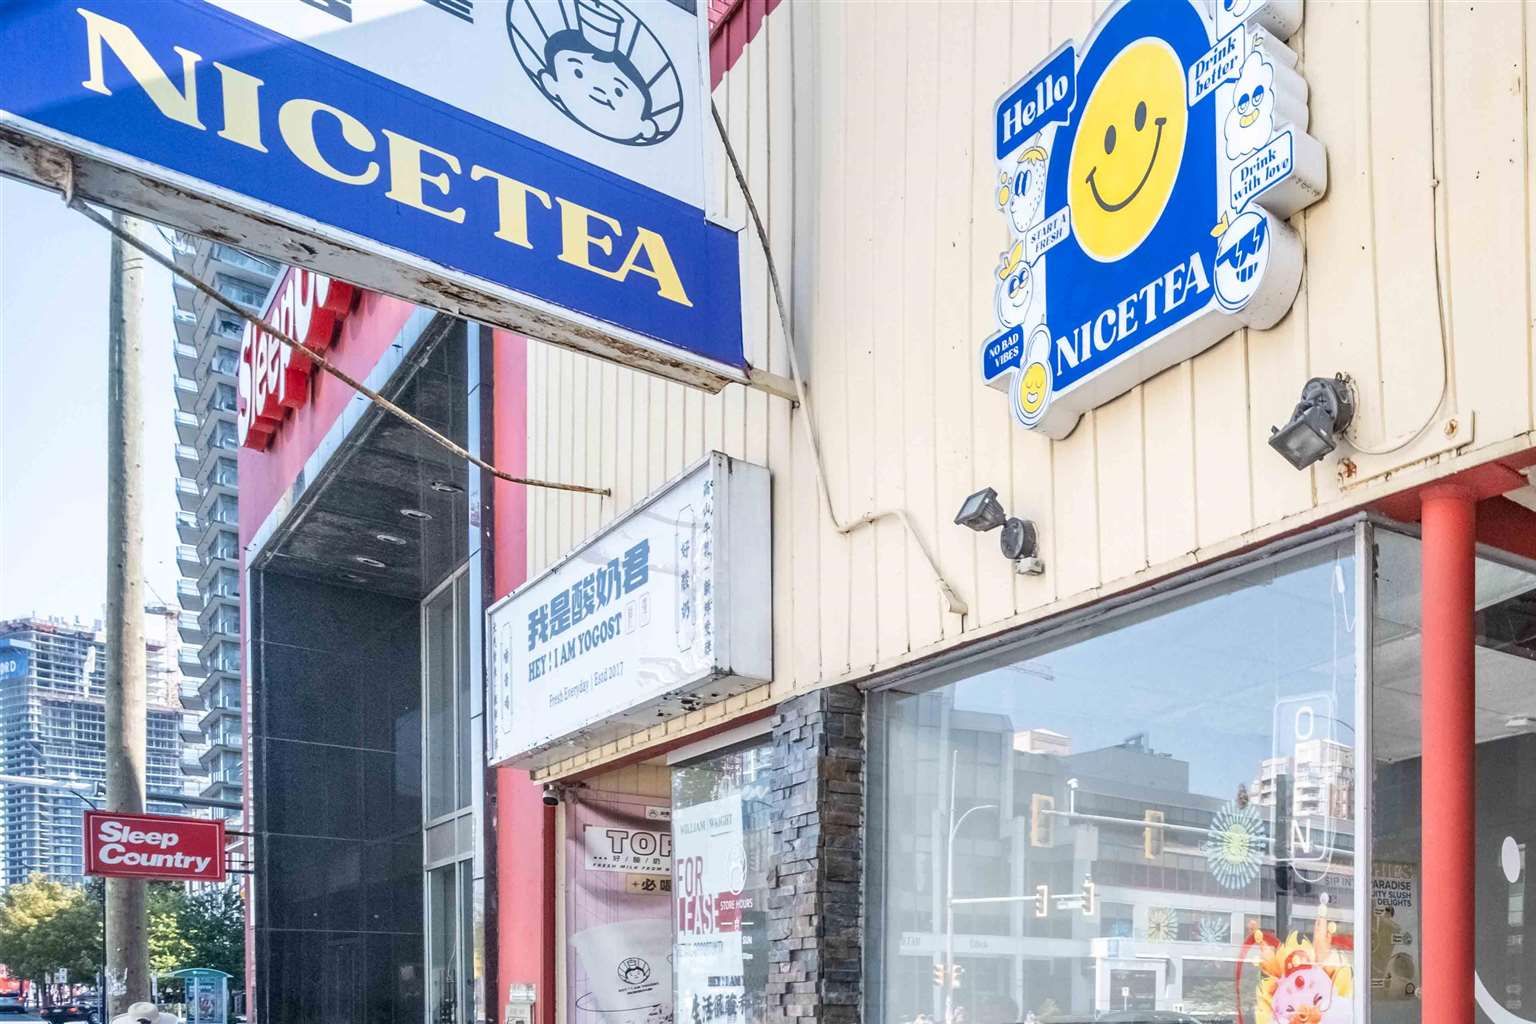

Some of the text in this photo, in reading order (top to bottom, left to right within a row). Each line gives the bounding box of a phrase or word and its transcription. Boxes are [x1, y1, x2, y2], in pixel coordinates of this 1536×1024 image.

[1195, 36, 1237, 80] Drink
[1195, 55, 1238, 98] better
[1002, 73, 1069, 145] Hello
[80, 7, 694, 308] NICETEA
[1240, 148, 1277, 183] Drink
[1233, 157, 1290, 202] with love
[1030, 218, 1059, 245] START
[1034, 227, 1063, 253] FRESH
[1055, 251, 1210, 377] NICETEA
[988, 332, 1019, 359] NO BAD
[995, 346, 1019, 369] VIBES
[528, 537, 650, 652] 我是酸奶君
[528, 654, 547, 683] HEY
[560, 637, 576, 666] AM
[98, 820, 180, 849] Sleep
[98, 843, 212, 873] Country
[677, 855, 704, 897] FOR
[1372, 879, 1412, 891] ARADISE
[1377, 897, 1412, 908] DELIGHTS
[1388, 890, 1412, 900] SLUSH
[677, 892, 721, 936] LEASE
